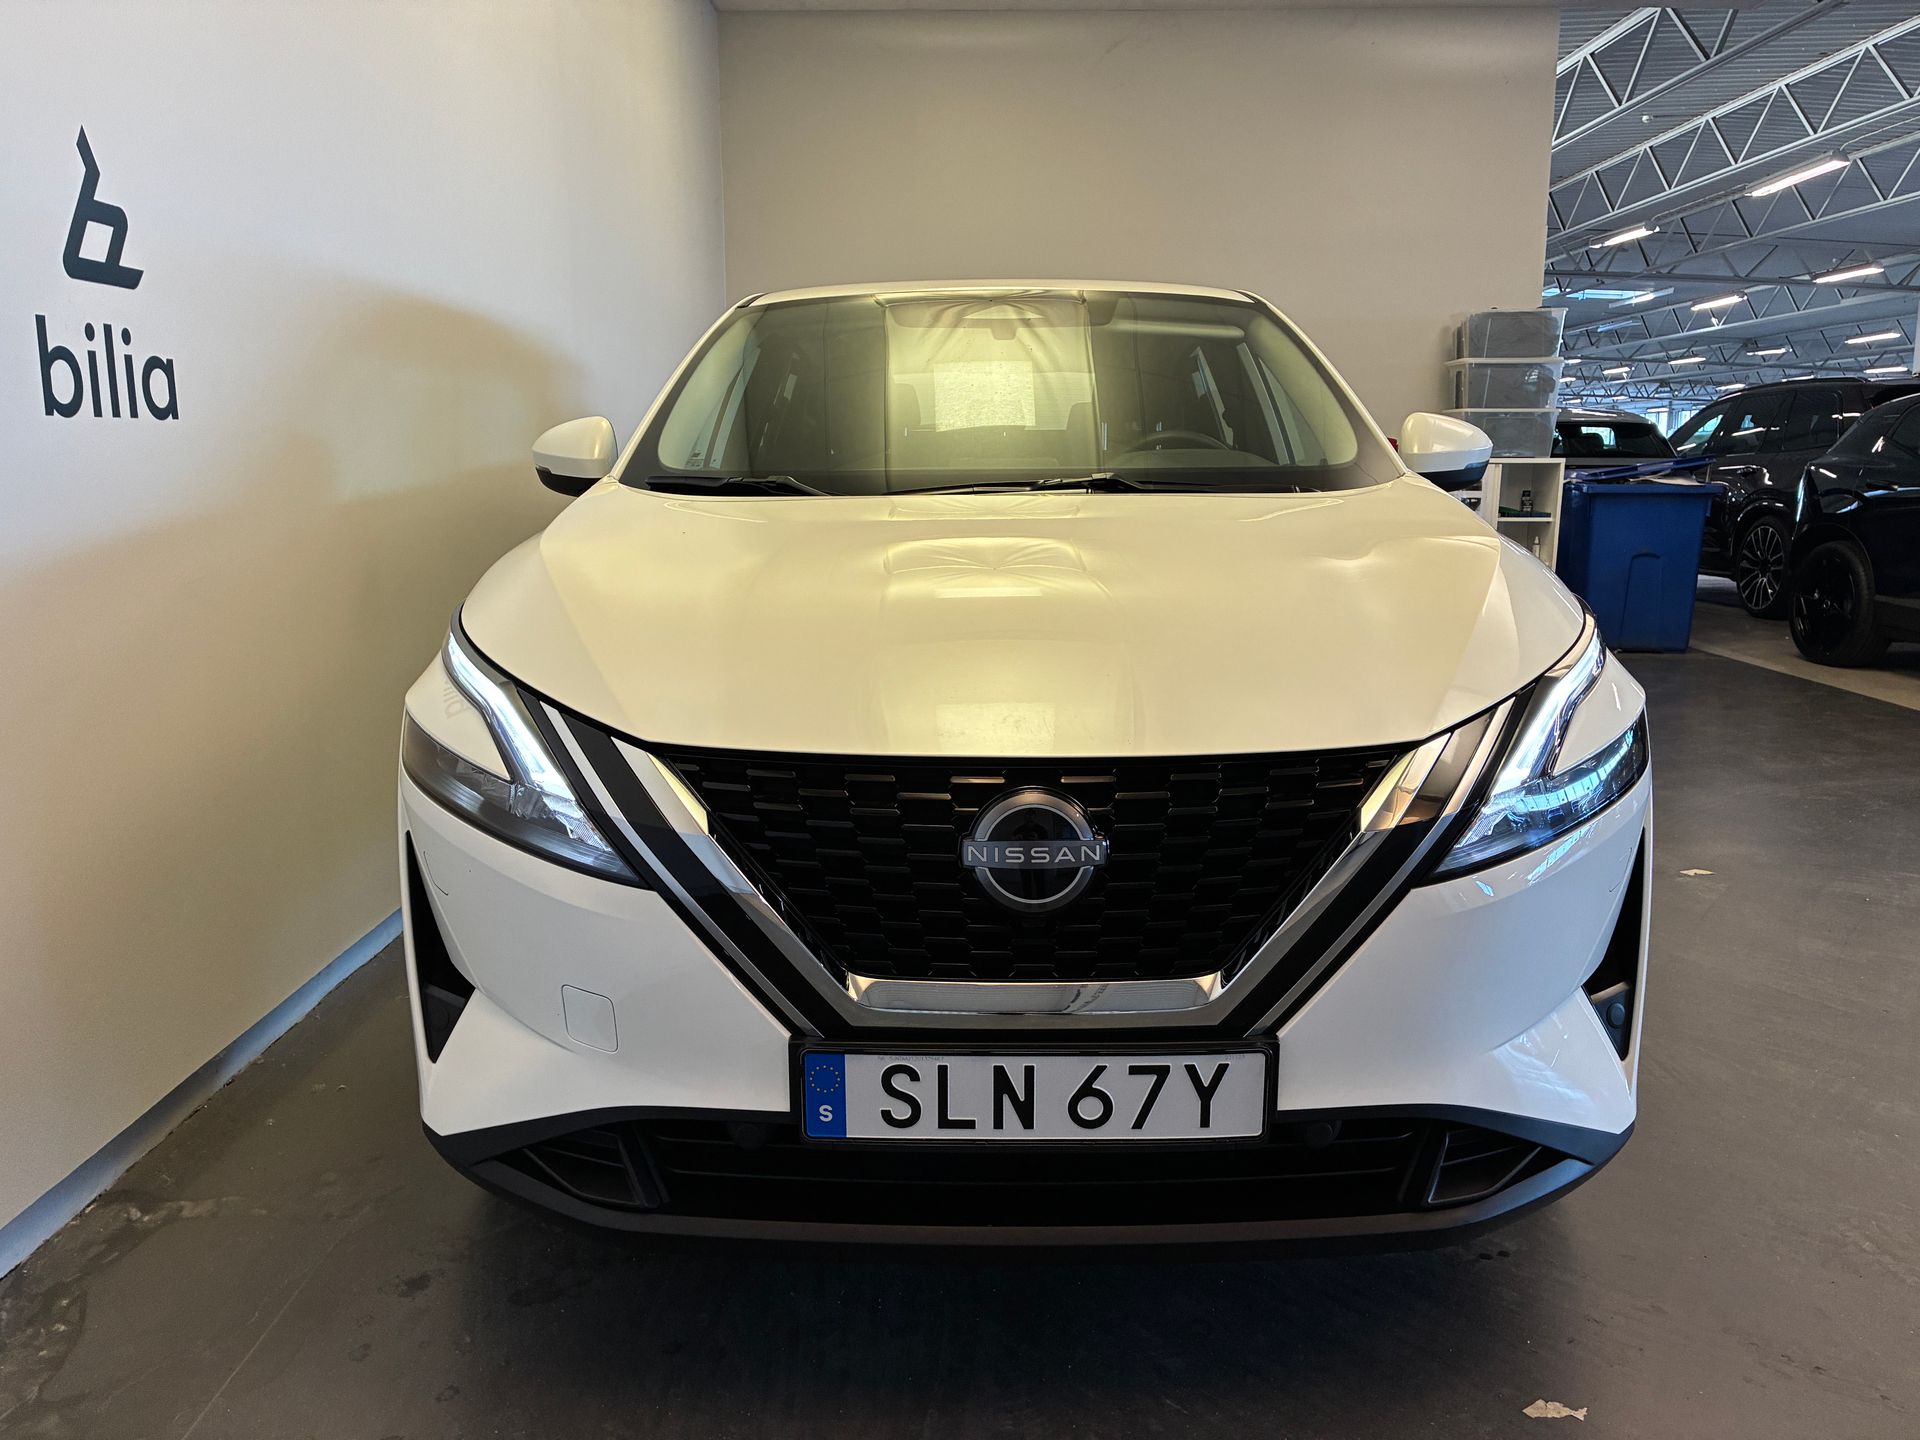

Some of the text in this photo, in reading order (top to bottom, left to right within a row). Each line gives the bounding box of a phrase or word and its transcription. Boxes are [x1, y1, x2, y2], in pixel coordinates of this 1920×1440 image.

[34, 313, 179, 421] bilia
[967, 844, 1100, 863] NISSAN
[818, 1104, 834, 1123] S
[880, 1063, 1230, 1130] SLN 67Y
